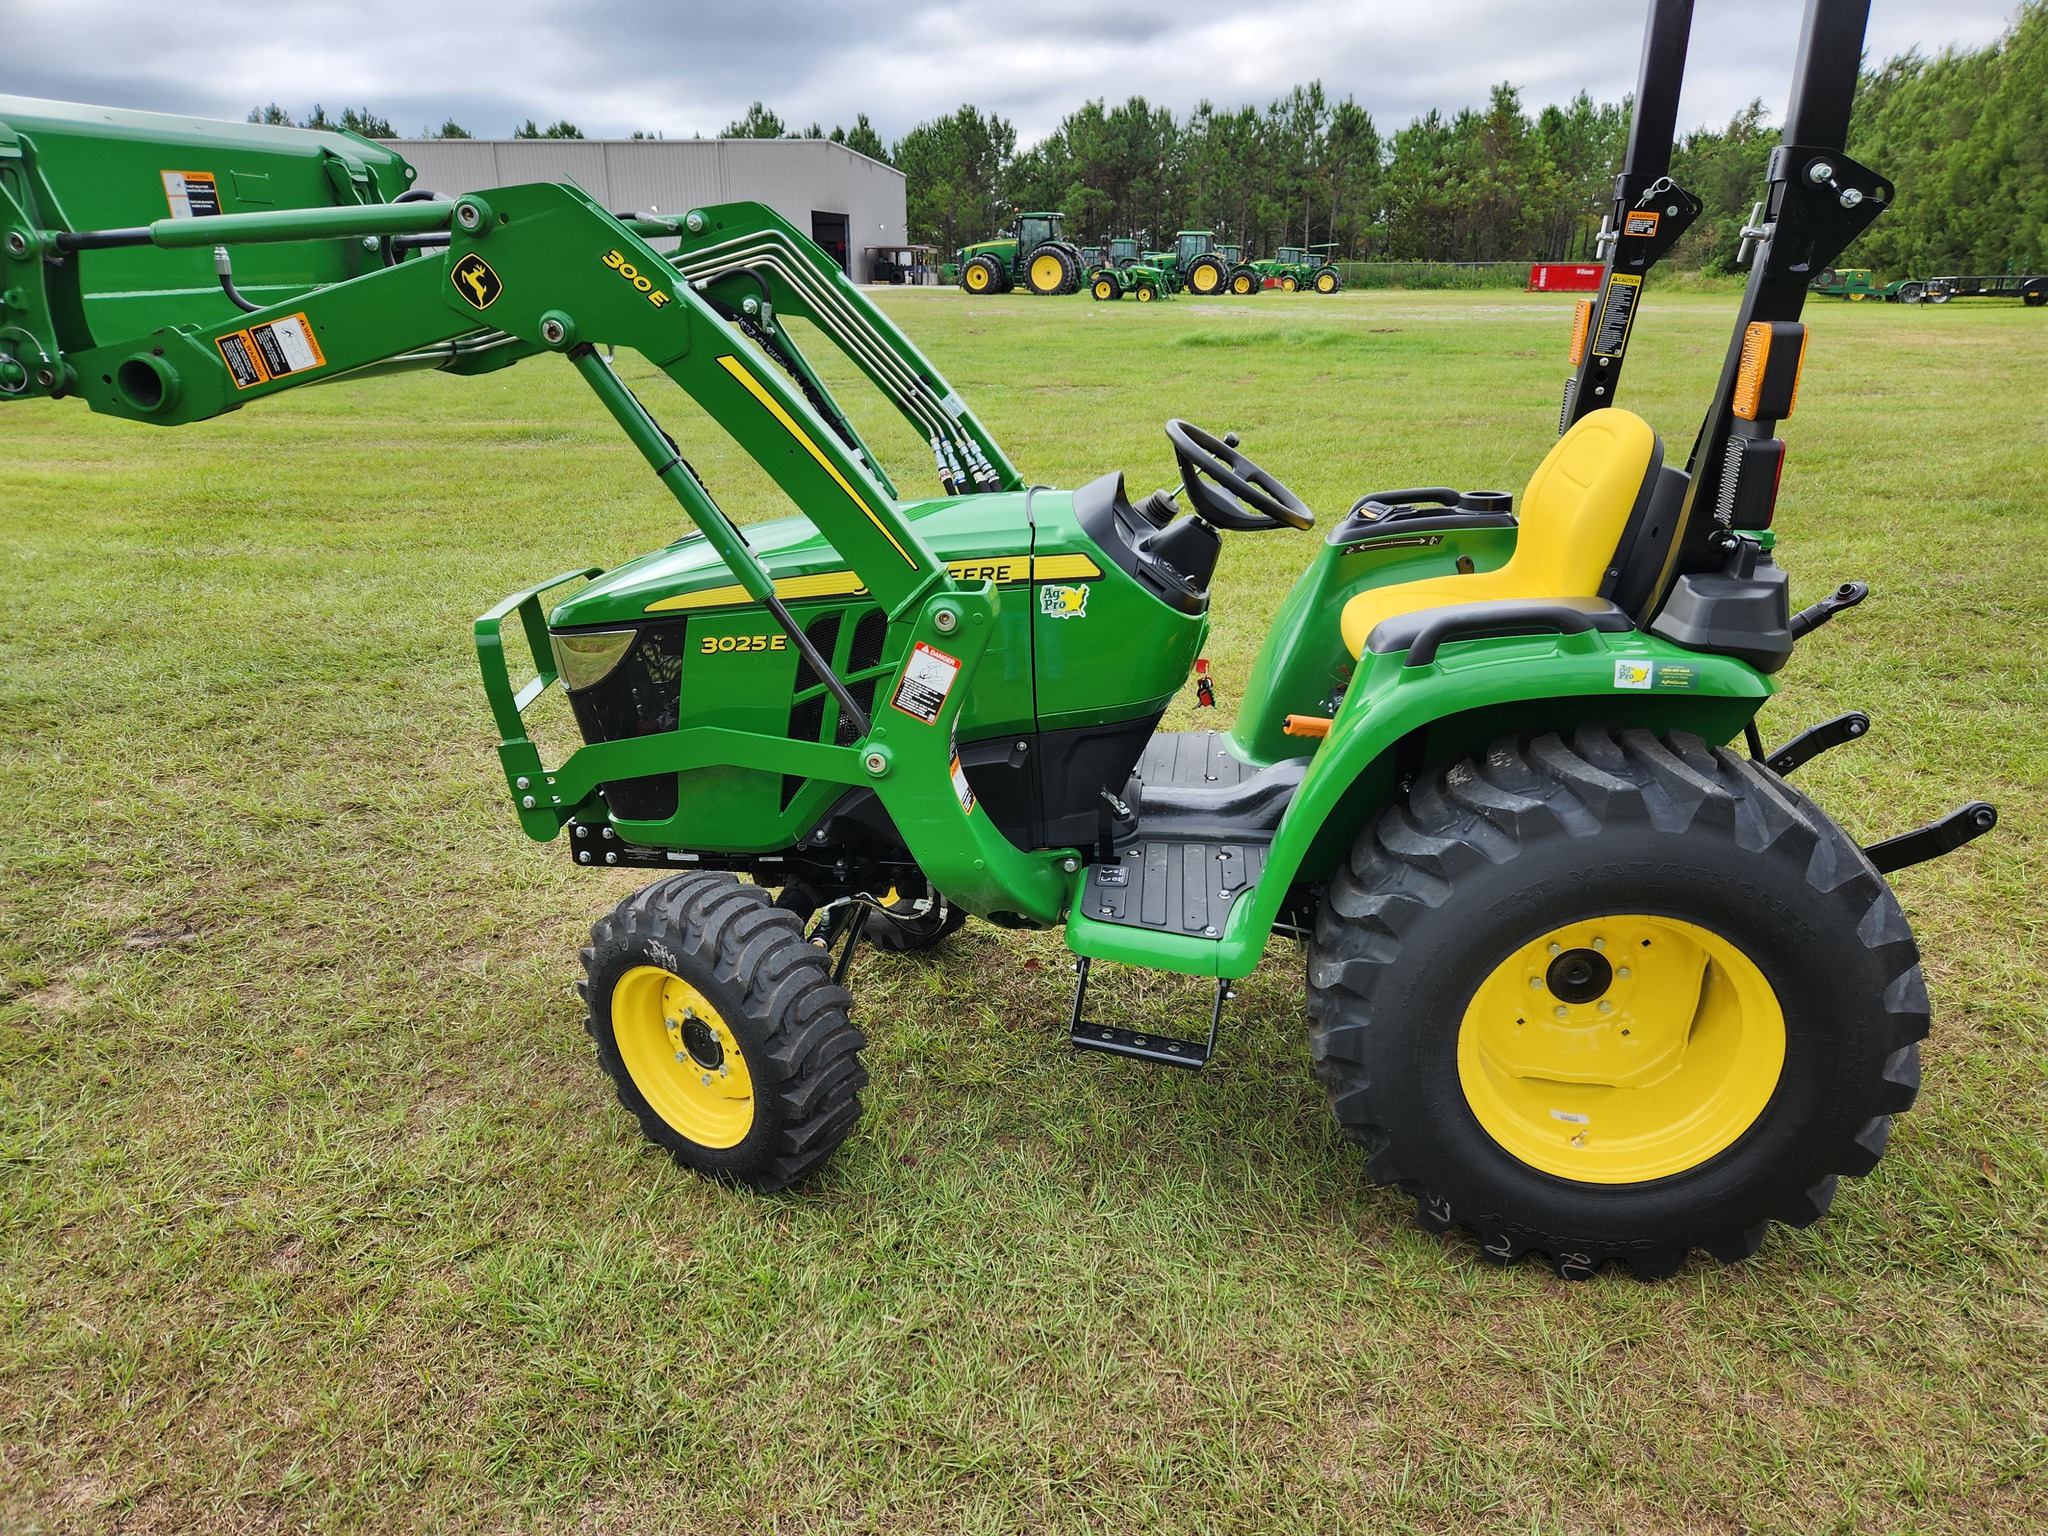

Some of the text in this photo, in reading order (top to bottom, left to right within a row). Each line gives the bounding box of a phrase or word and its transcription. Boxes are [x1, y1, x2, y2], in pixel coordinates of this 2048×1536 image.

[303, 326, 322, 360] WARNING
[246, 344, 265, 378] WARNING
[948, 565, 1011, 581] EERE
[1043, 599, 1066, 611] Pro
[929, 649, 956, 666] DANGER
